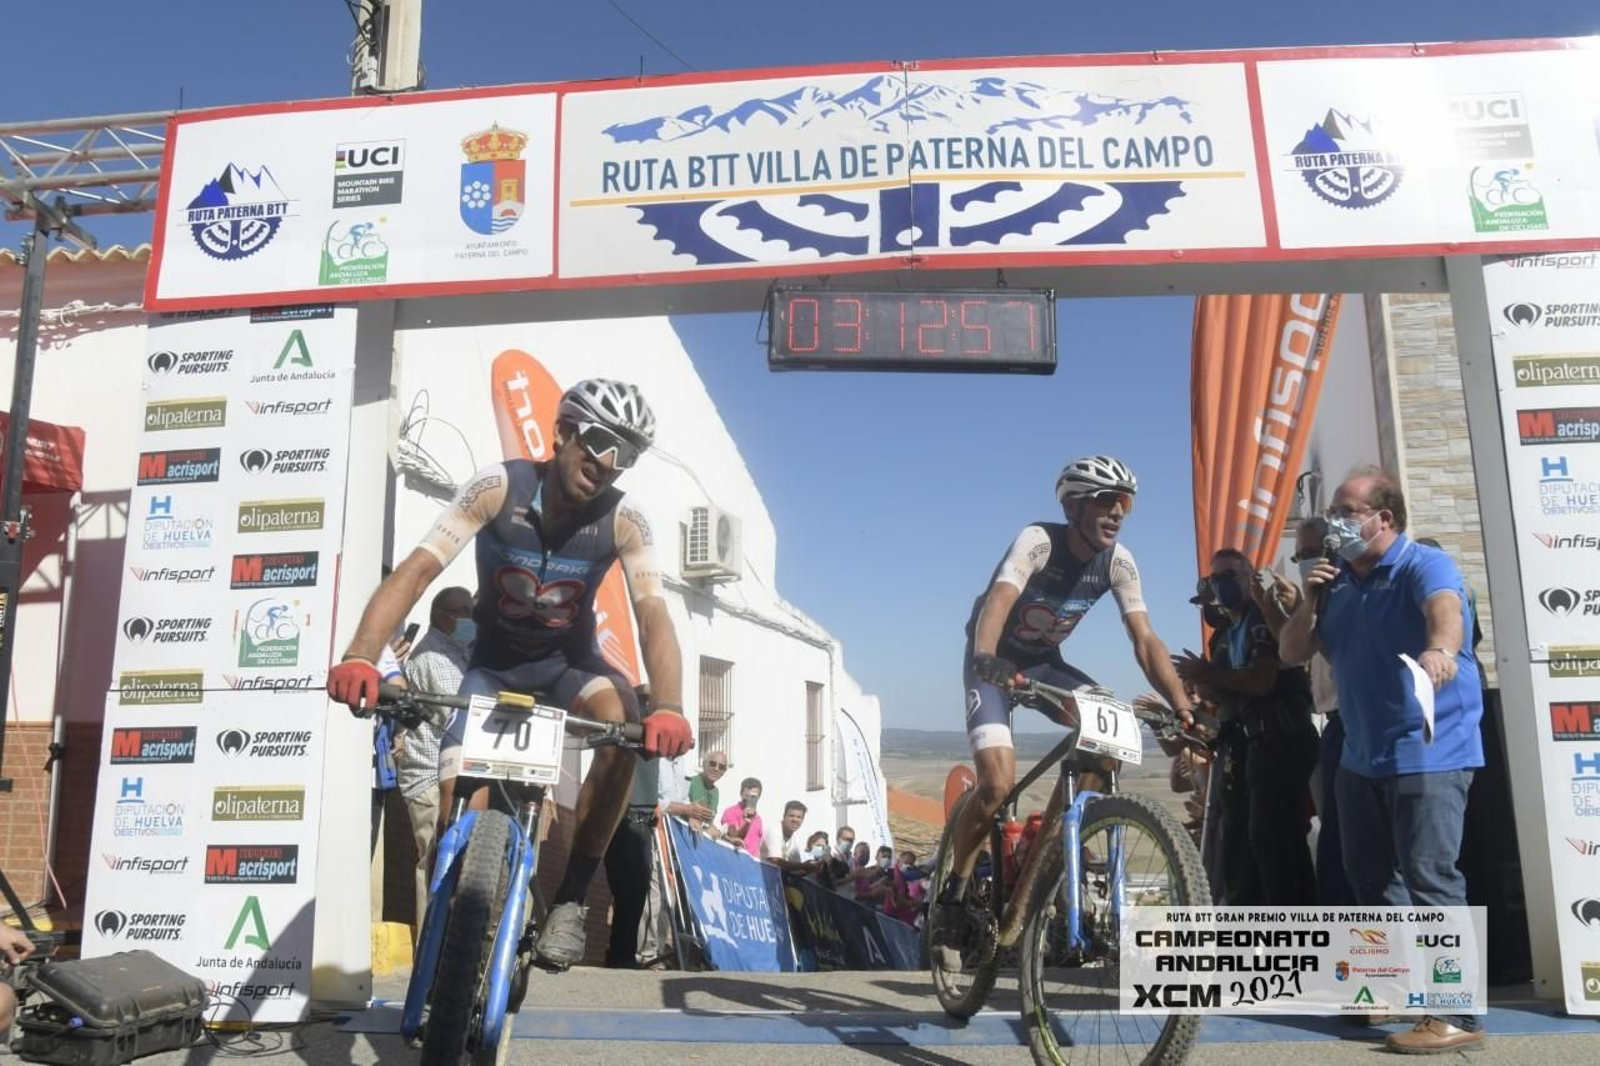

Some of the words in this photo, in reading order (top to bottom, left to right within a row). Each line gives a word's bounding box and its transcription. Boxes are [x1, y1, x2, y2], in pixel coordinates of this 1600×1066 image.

[348, 146, 399, 168] UCI
[602, 158, 678, 193] RUTA
[688, 153, 740, 188] BTT
[747, 149, 832, 184] VILLA
[840, 144, 879, 179] DE
[886, 136, 1030, 175] PATERNA
[1037, 136, 1094, 169] DEL
[1102, 134, 1213, 169] CAMPO
[1295, 155, 1327, 168] RUTA
[1329, 152, 1384, 166] PATERNA
[338, 179, 377, 187] MOUNTAIN
[337, 186, 380, 195] MARATHON
[188, 207, 215, 222] RUTA
[217, 204, 265, 219] PATERNA
[266, 202, 289, 216] BTT
[1545, 303, 1600, 315] SPORTIN
[180, 350, 234, 362] SPORTING
[250, 374, 275, 383] Junta
[277, 373, 288, 381] de
[260, 398, 332, 415] infisport
[147, 407, 221, 429] olipaterna
[275, 448, 330, 460] SPORTING
[1541, 497, 1559, 507] DE
[240, 507, 320, 530] olipaterna
[143, 531, 157, 541] DE
[163, 529, 211, 541] HUELVA
[143, 566, 215, 583] infisport
[156, 618, 212, 630] SPORTING
[1097, 706, 1118, 738] 67
[252, 731, 312, 743] SPORTING
[492, 719, 531, 751] 70
[215, 792, 300, 819] olipaterna
[114, 817, 129, 827] DE
[135, 816, 182, 827] HUELVA
[115, 856, 189, 874] infisport
[129, 913, 186, 926] SPORTING
[196, 956, 227, 968] Junta
[230, 957, 244, 968] de
[214, 981, 297, 1000] infisport
